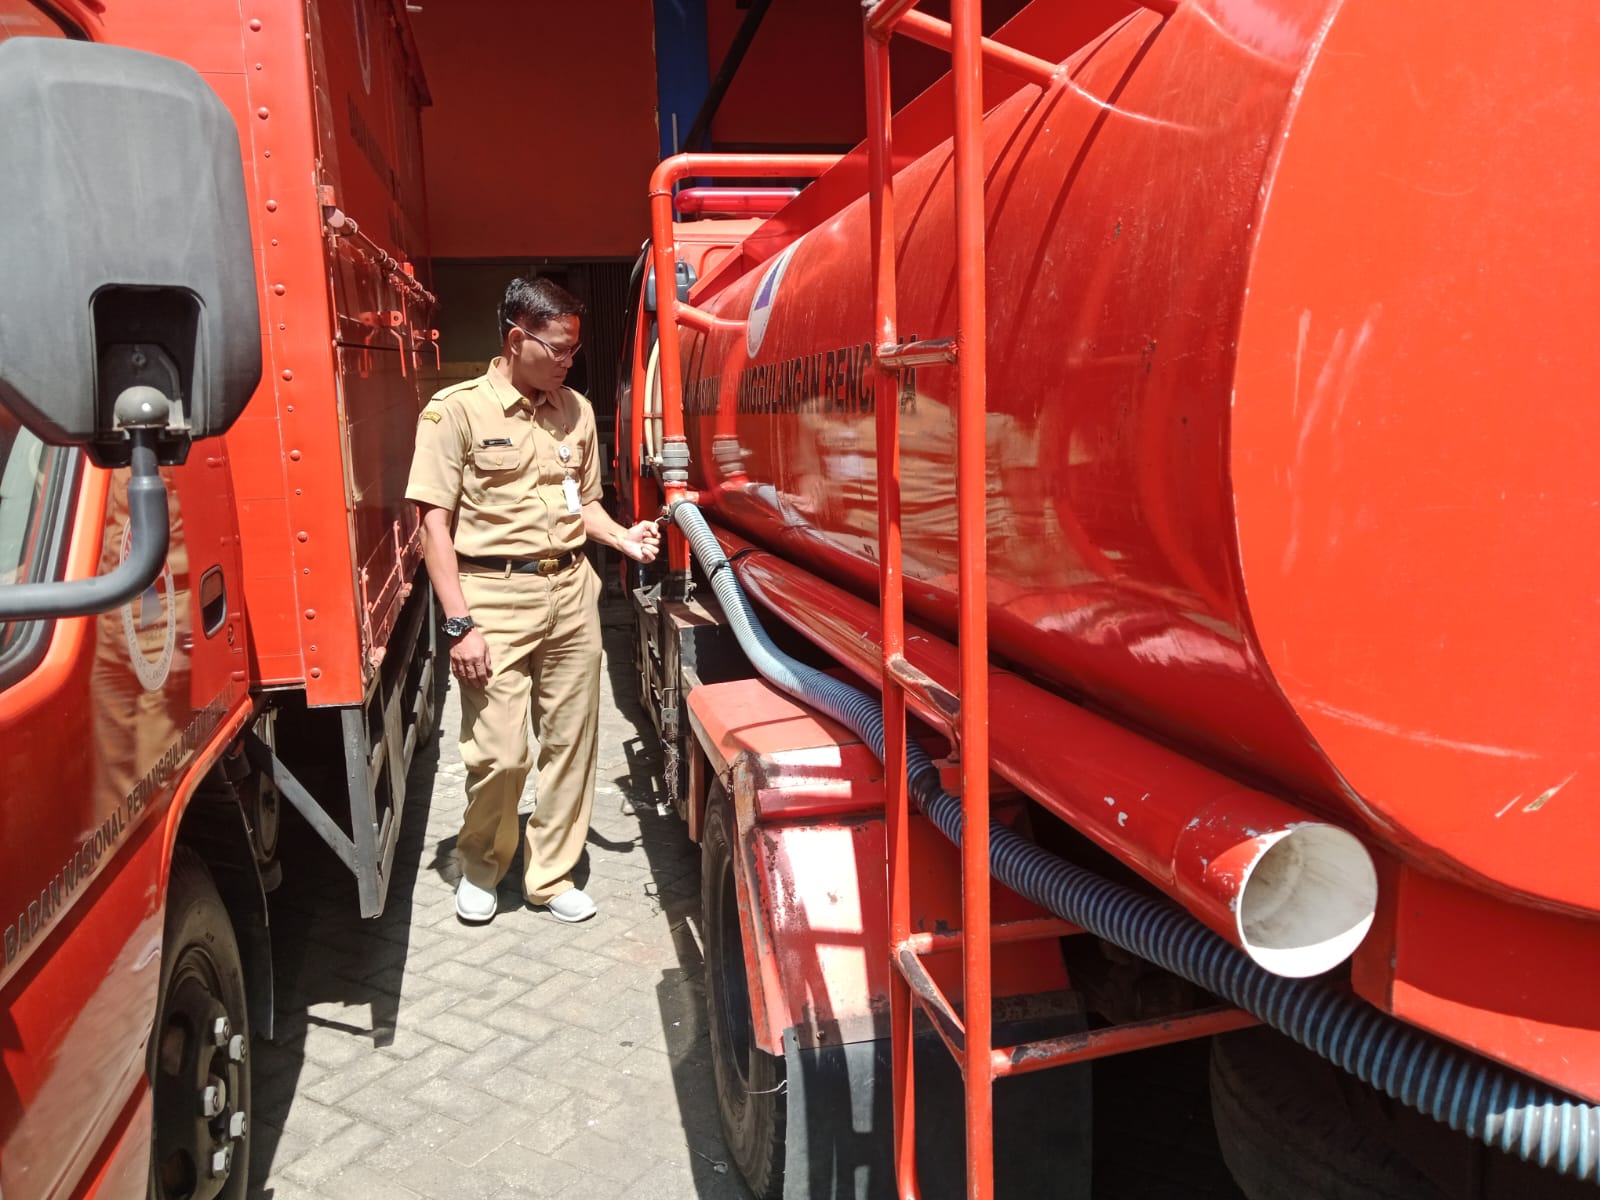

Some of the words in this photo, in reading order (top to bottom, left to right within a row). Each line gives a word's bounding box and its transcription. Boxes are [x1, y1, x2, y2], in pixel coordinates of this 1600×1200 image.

[737, 352, 823, 416] ANGGULANGAN
[824, 334, 918, 415] BENCA
[4, 872, 62, 965] BADAN
[63, 808, 126, 898] NASIONAL
